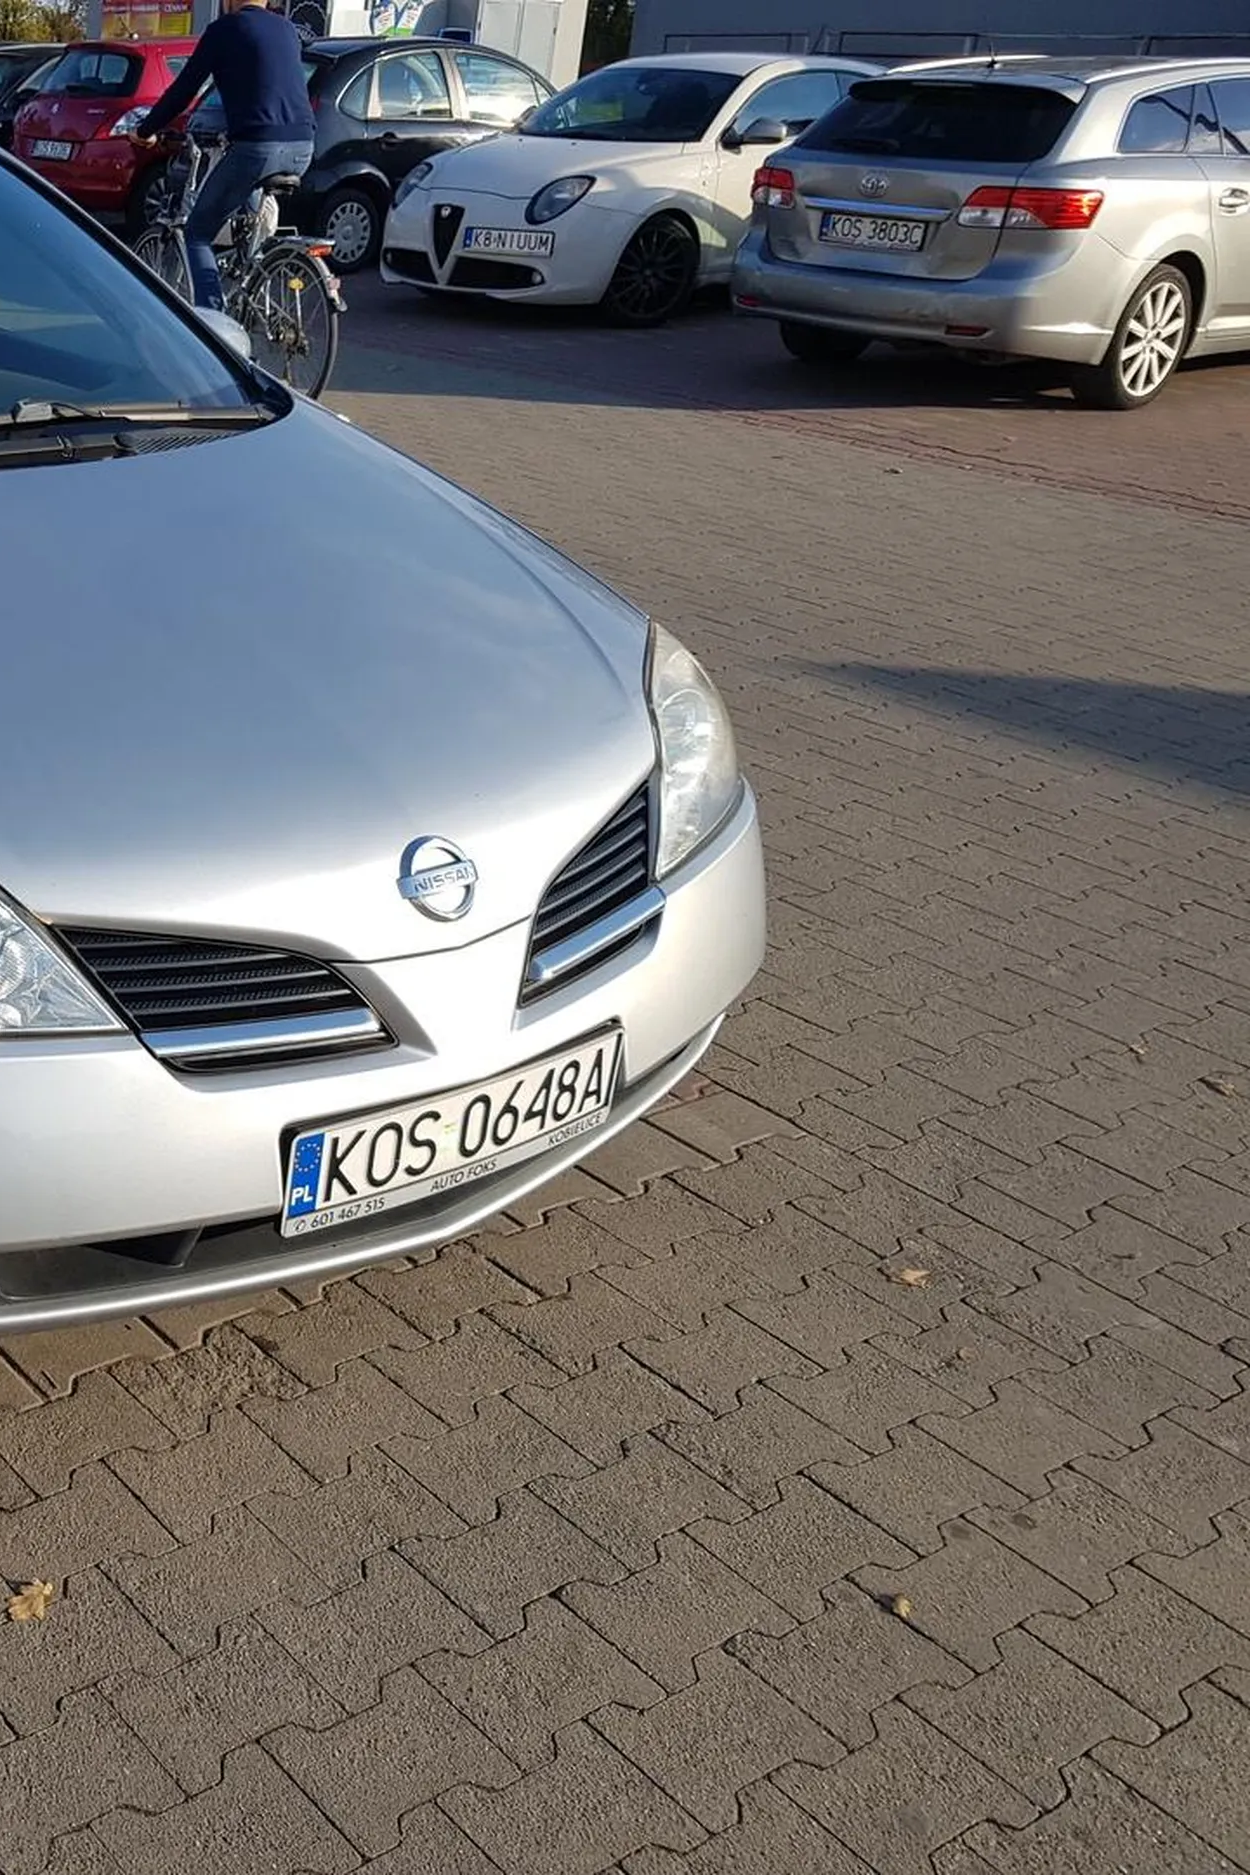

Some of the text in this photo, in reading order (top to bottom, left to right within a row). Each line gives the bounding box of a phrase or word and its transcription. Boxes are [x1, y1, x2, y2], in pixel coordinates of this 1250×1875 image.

[831, 217, 922, 244] KOS 3803C
[414, 867, 474, 892] NISSAN
[291, 1048, 603, 1206] PL KOS 0648A
[311, 1211, 334, 1228] 601
[338, 1204, 361, 1220] 467
[364, 1197, 385, 1213] 515
[430, 1171, 464, 1192] AUTO
[467, 1159, 497, 1181] FOKS
